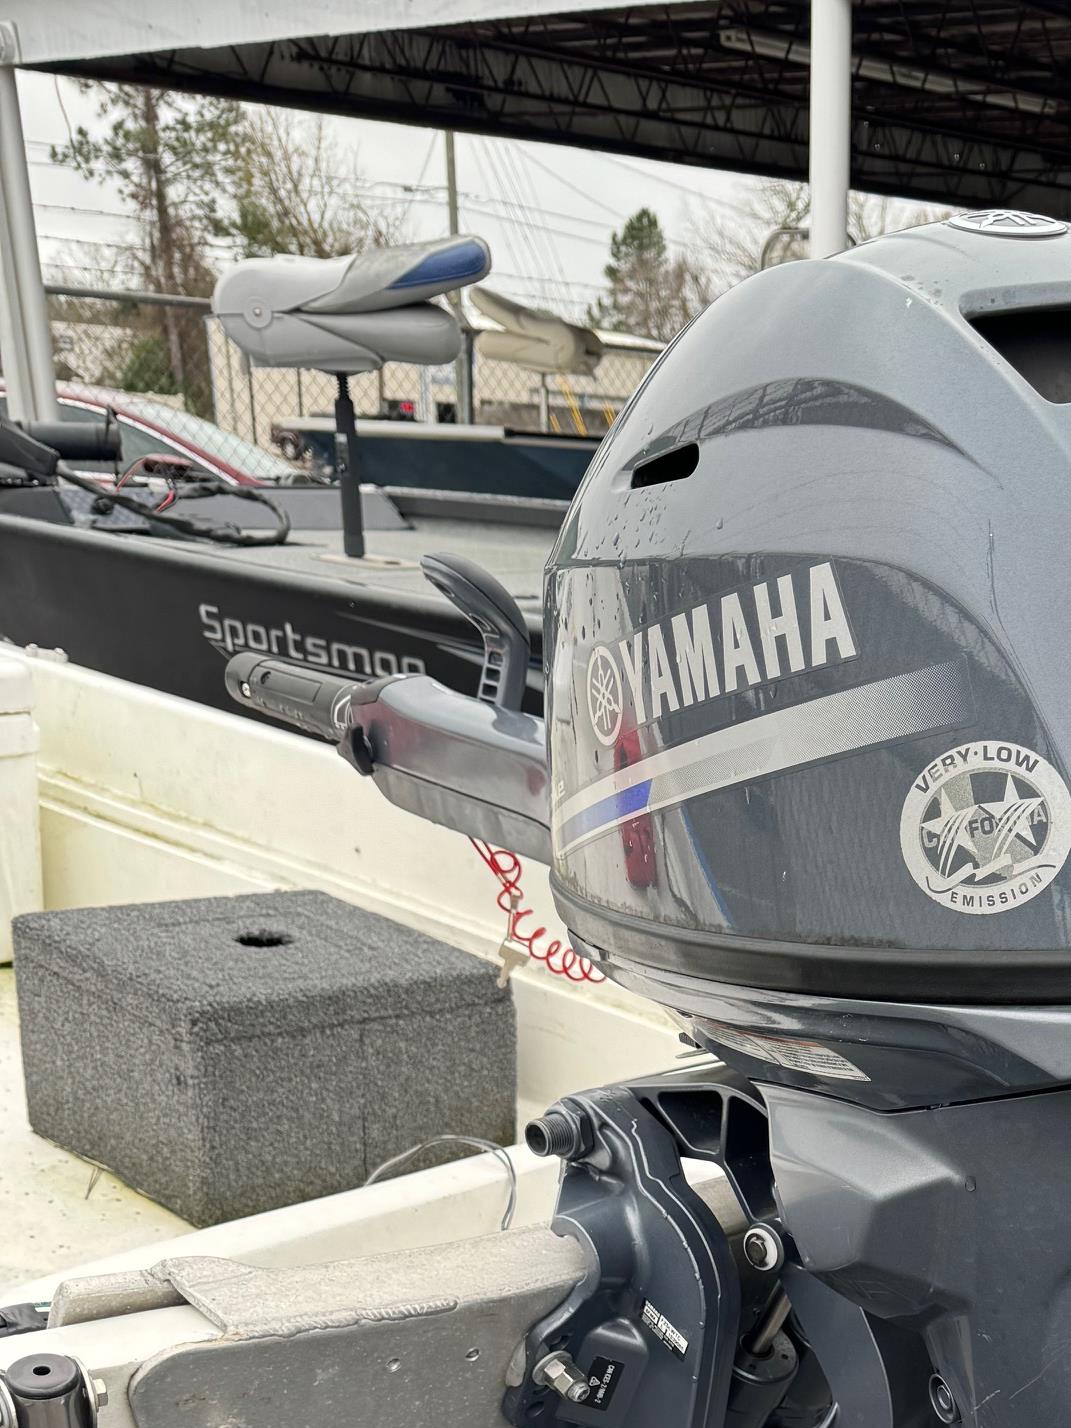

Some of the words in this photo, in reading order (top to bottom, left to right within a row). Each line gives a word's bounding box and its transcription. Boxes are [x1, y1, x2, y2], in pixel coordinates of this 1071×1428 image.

[199, 603, 426, 676] Sportsman
[618, 562, 857, 724] YAMAHA
[950, 872, 1043, 908] EMISSION
